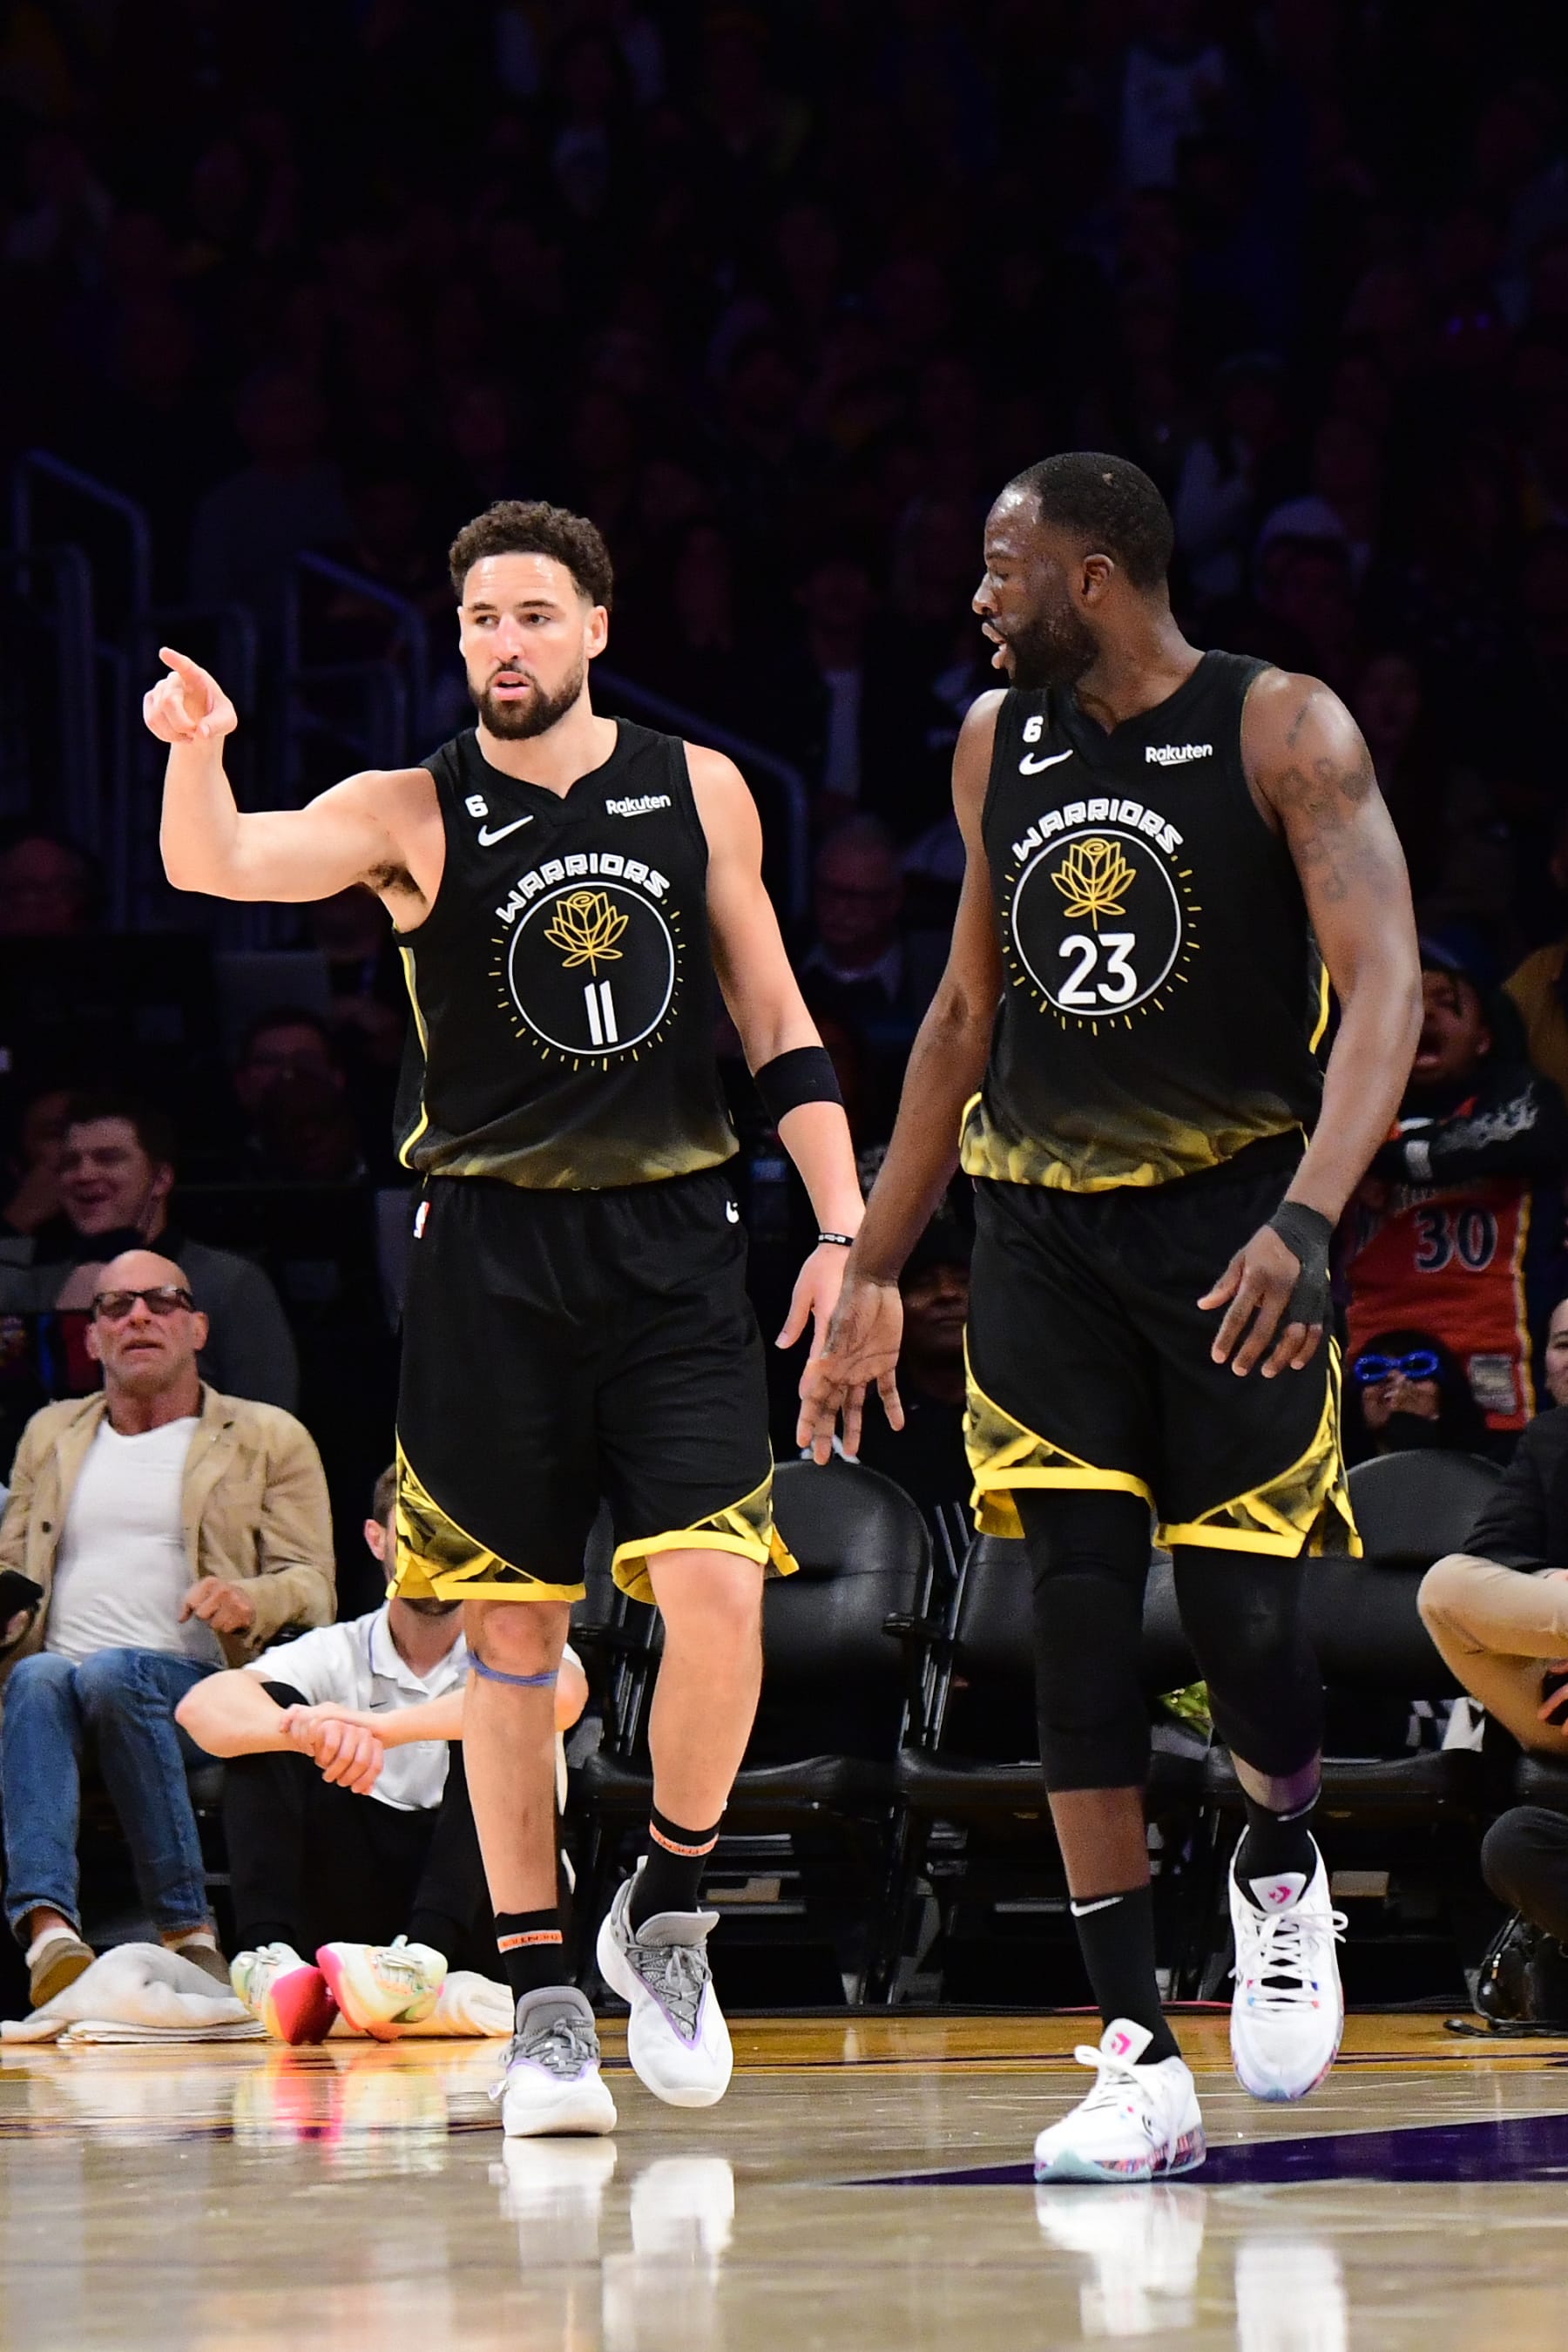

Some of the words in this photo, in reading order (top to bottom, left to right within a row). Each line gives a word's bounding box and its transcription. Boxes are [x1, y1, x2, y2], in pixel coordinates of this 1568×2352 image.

[1022, 715, 1044, 743] 6
[1145, 743, 1213, 767] Rakuten
[464, 794, 489, 818] 6
[605, 794, 672, 818] Rakuten
[1011, 798, 1184, 862] WARRIORS
[495, 853, 671, 924] WARRIORS
[1057, 932, 1139, 1004] 23
[584, 980, 618, 1046] 11
[1413, 1206, 1498, 1274] 30
